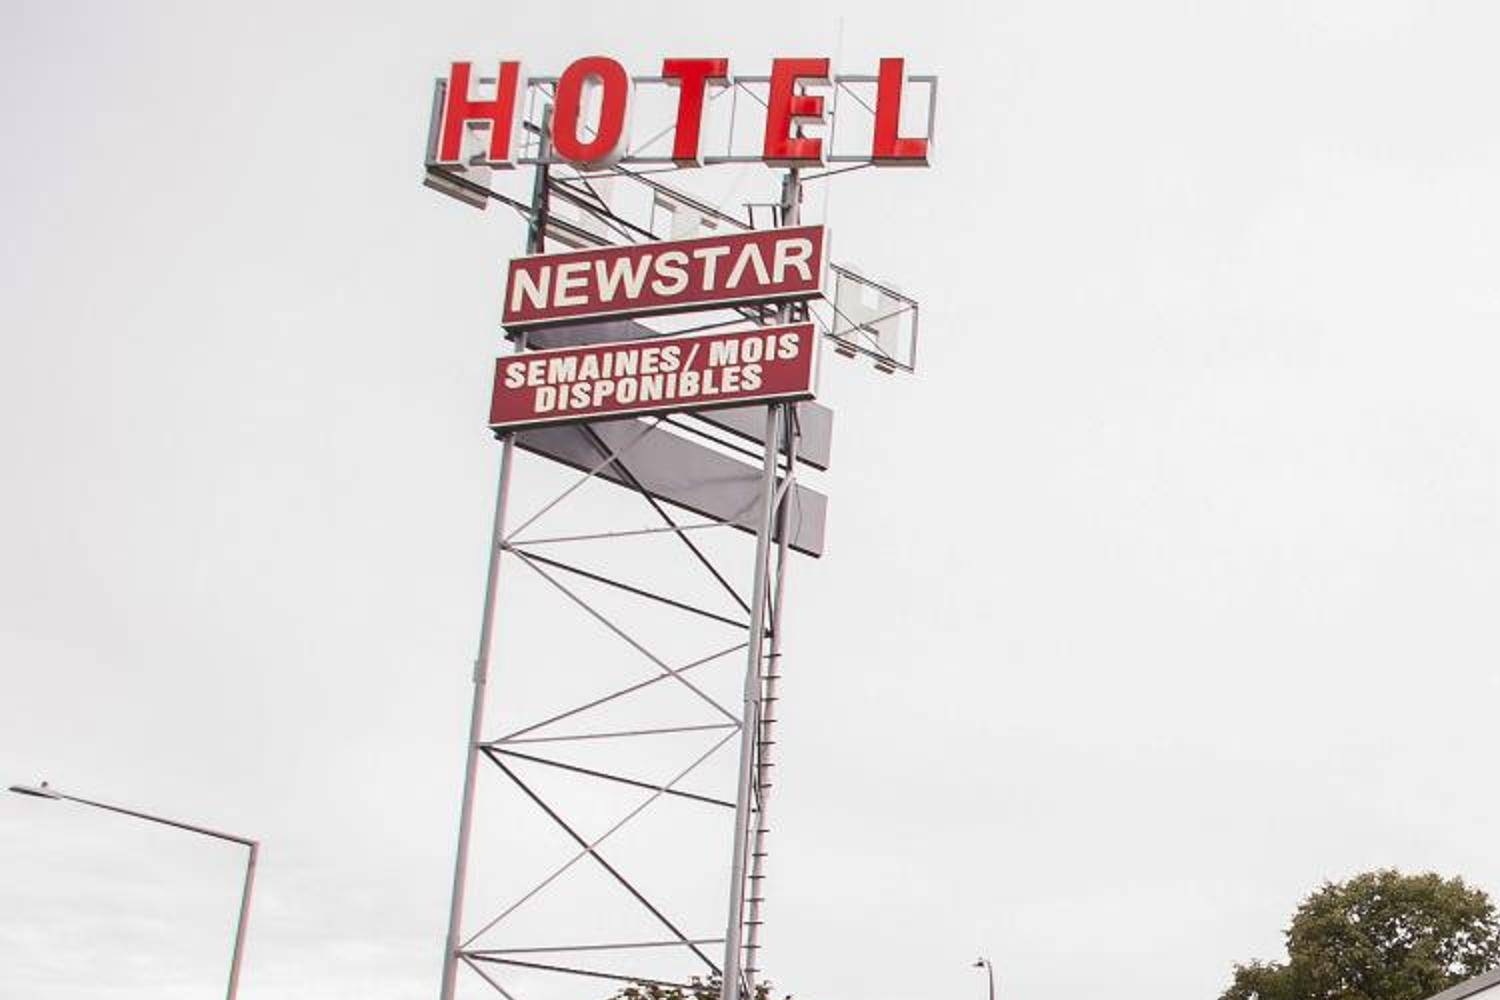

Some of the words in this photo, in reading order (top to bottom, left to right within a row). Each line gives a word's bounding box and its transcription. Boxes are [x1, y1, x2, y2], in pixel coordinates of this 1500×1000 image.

[435, 56, 931, 168] HOTEL
[509, 237, 813, 312] NEWSTAR
[708, 333, 800, 367] MOIS
[533, 364, 764, 413] DISPONIBLES
